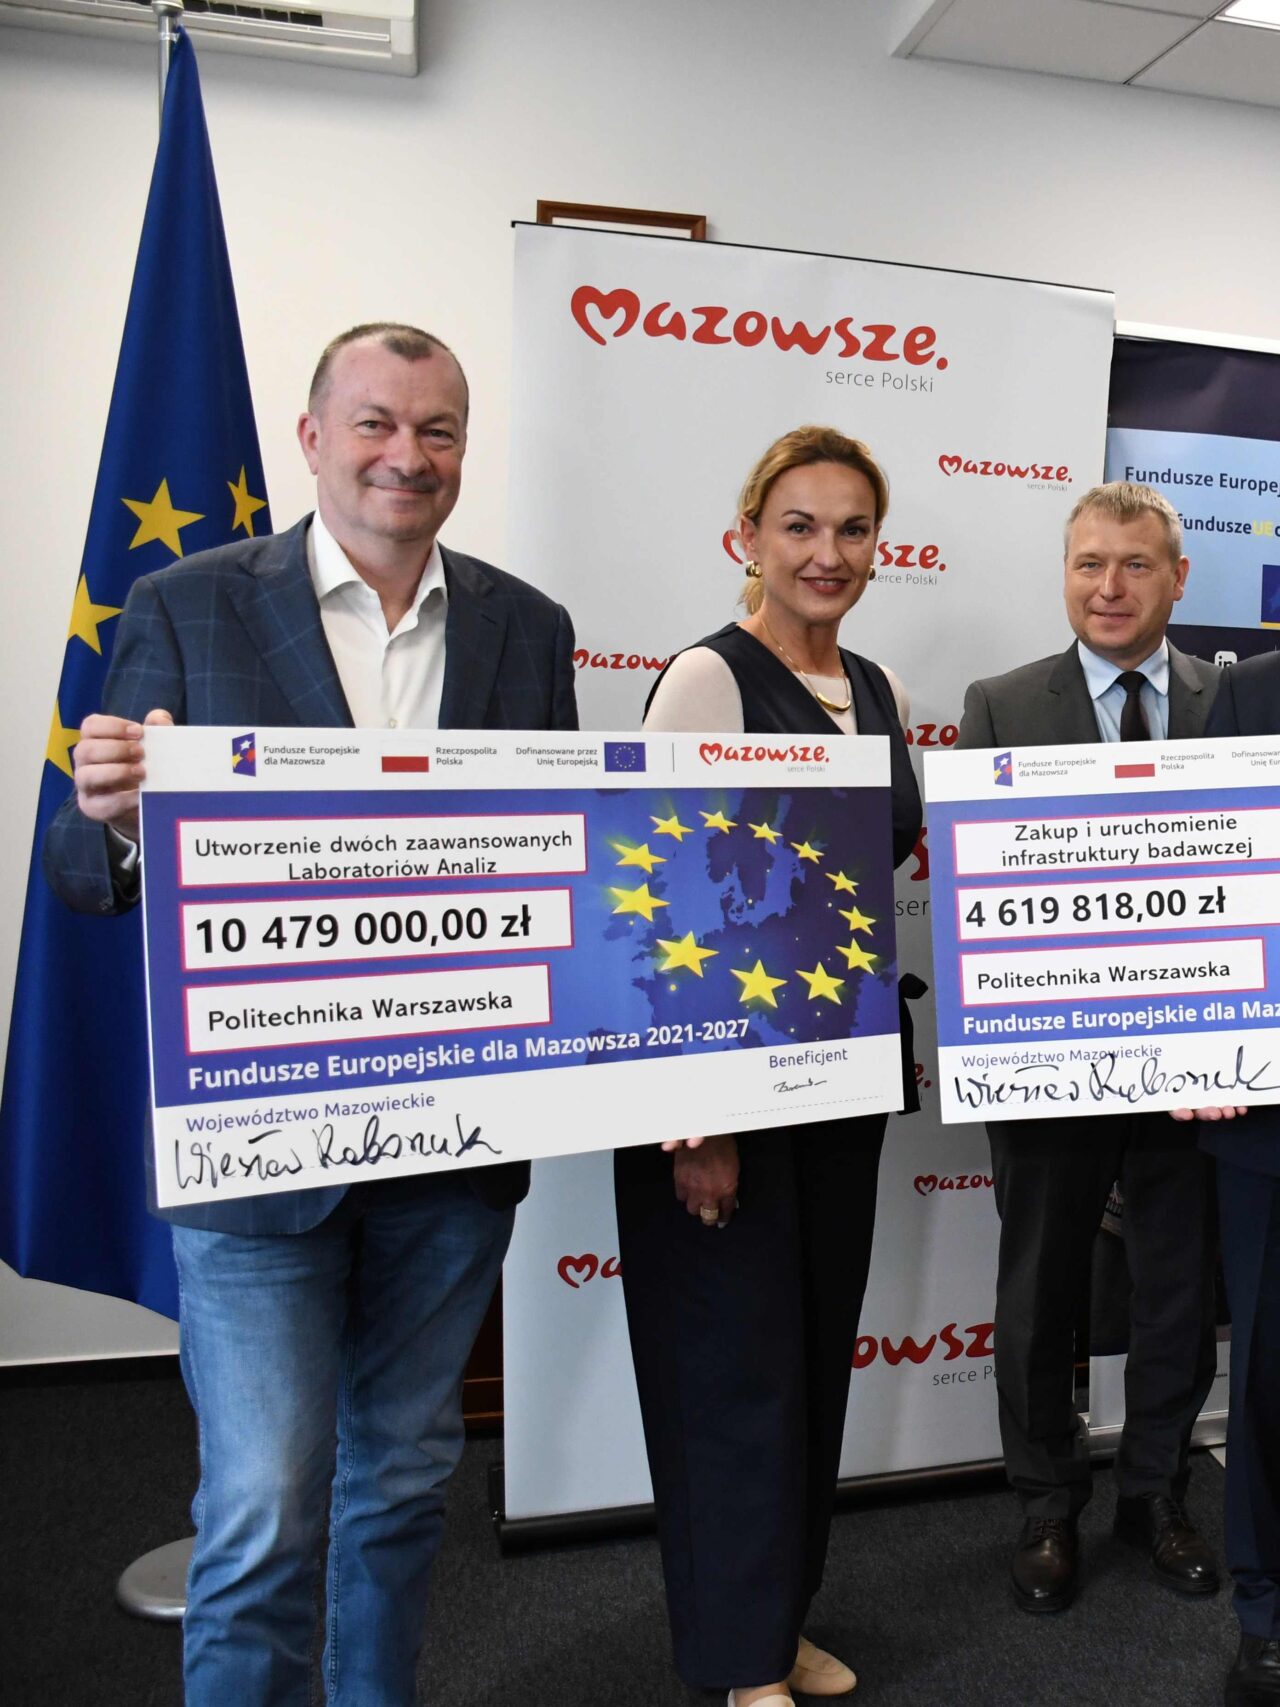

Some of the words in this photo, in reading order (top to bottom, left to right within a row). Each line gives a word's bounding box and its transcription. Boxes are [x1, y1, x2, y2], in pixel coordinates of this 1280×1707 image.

[571, 285, 948, 370] Mazowsze.
[826, 369, 874, 389] serce
[882, 371, 934, 393] Polski
[1125, 466, 1213, 487] Fundusze
[1047, 483, 1068, 492] Polski
[906, 573, 937, 585] Polski
[263, 746, 306, 755] Fundusze
[309, 746, 360, 756] Europejskie
[264, 757, 278, 766] dla
[280, 757, 326, 766] Mazowsza
[436, 747, 498, 757] Rzeczpospolita
[436, 757, 464, 766] Polska
[516, 747, 576, 756] Dofinansowane
[577, 749, 598, 757] przez
[1160, 752, 1215, 763] Rzeczpospolita
[535, 757, 555, 767] Unię
[556, 757, 598, 768] Europejską
[1018, 759, 1052, 768] Fundusze
[1054, 758, 1097, 768] Europejskie
[1019, 769, 1029, 777] dla
[1031, 768, 1069, 777] Mazowsza
[1161, 762, 1185, 771] Polska
[1251, 758, 1267, 768] Unię
[1014, 823, 1079, 843] Zakup
[1086, 821, 1092, 838] i
[1100, 814, 1238, 838] uruchomienie
[195, 837, 321, 857] Utworzenie
[330, 834, 397, 853] dwóch
[406, 830, 572, 852] zaawansowanych
[1001, 844, 1140, 867] infrastruktury
[1148, 837, 1253, 859] badawczej
[289, 859, 429, 881] Laboratoriów
[437, 858, 497, 876] Analiz
[965, 900, 986, 928] 4
[998, 897, 1060, 926] 619
[1073, 889, 1187, 923] 818,00
[1198, 885, 1226, 915] zł
[196, 918, 247, 954] 10
[262, 914, 339, 951] 479
[354, 907, 487, 947] 000,00
[501, 904, 532, 937] zł
[977, 968, 1101, 990] Politechnika
[1108, 961, 1231, 983] Warszawska
[208, 1001, 363, 1032] Politechnika
[372, 990, 513, 1019] Warszawska
[963, 1013, 1066, 1035] Fundusze
[1072, 1003, 1198, 1031] Europejskie
[1203, 1002, 1236, 1021] dla
[188, 1058, 320, 1090] Fundusze
[328, 1043, 475, 1077] Europejskie
[482, 1040, 519, 1062] dla
[525, 1032, 641, 1058] Mazowsza
[646, 1018, 750, 1047] 2021-2027
[769, 1047, 849, 1069] Beneficjent
[961, 1051, 1065, 1068] Województwo
[1069, 1044, 1163, 1062] Mazowieckie
[186, 1104, 319, 1133] Województwo
[324, 1092, 435, 1118] Mazowieckie
[932, 1370, 977, 1387] serce
